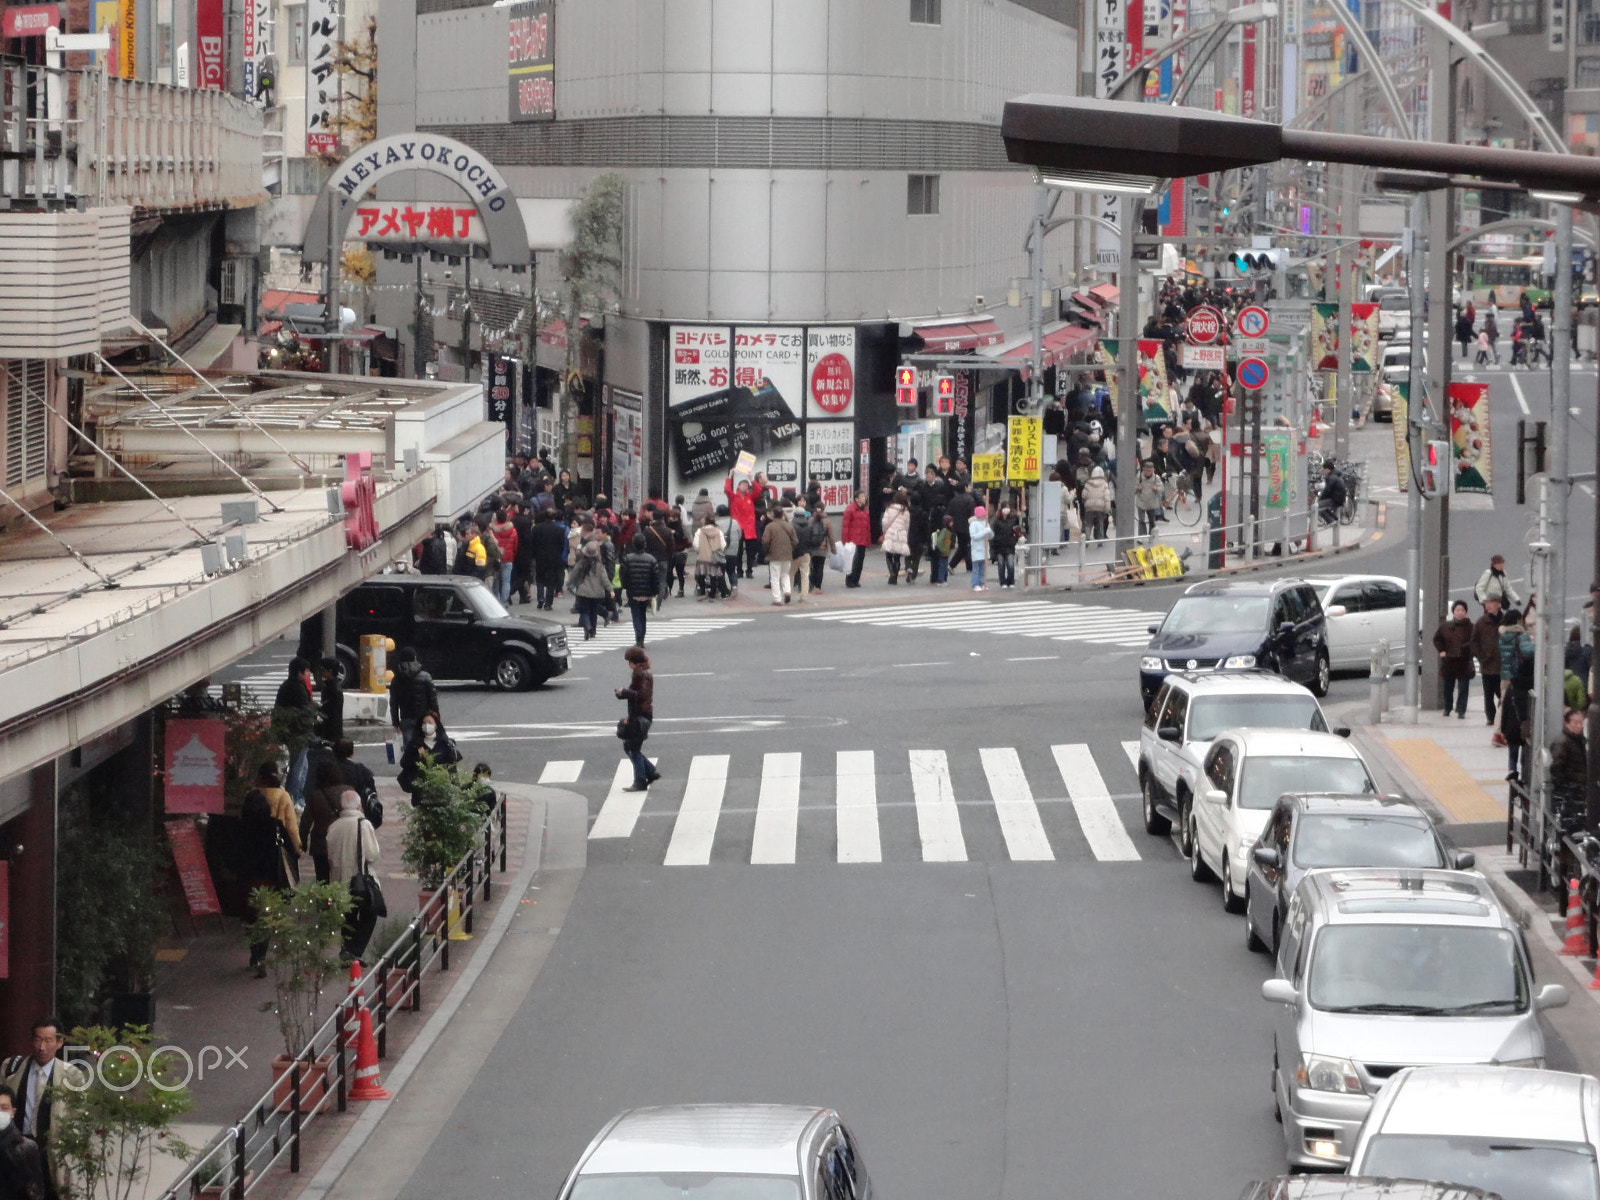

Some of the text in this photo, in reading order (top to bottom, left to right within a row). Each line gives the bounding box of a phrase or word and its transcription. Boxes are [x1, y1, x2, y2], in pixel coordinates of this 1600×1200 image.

[200, 36, 221, 79] BIG
[356, 206, 478, 238] アメヤ横丁
[1191, 321, 1217, 333] 消火栓
[704, 349, 730, 359] GOLD
[734, 350, 763, 359] POINT
[766, 351, 791, 360] CARD
[816, 378, 850, 391] 新規会員
[772, 422, 800, 439] VISA
[1391, 384, 1408, 489] MERRY CHRISTMAS
[1023, 418, 1037, 471] キリストの血
[1271, 454, 1281, 504] スクラッチ
[817, 485, 853, 506] 補償!
